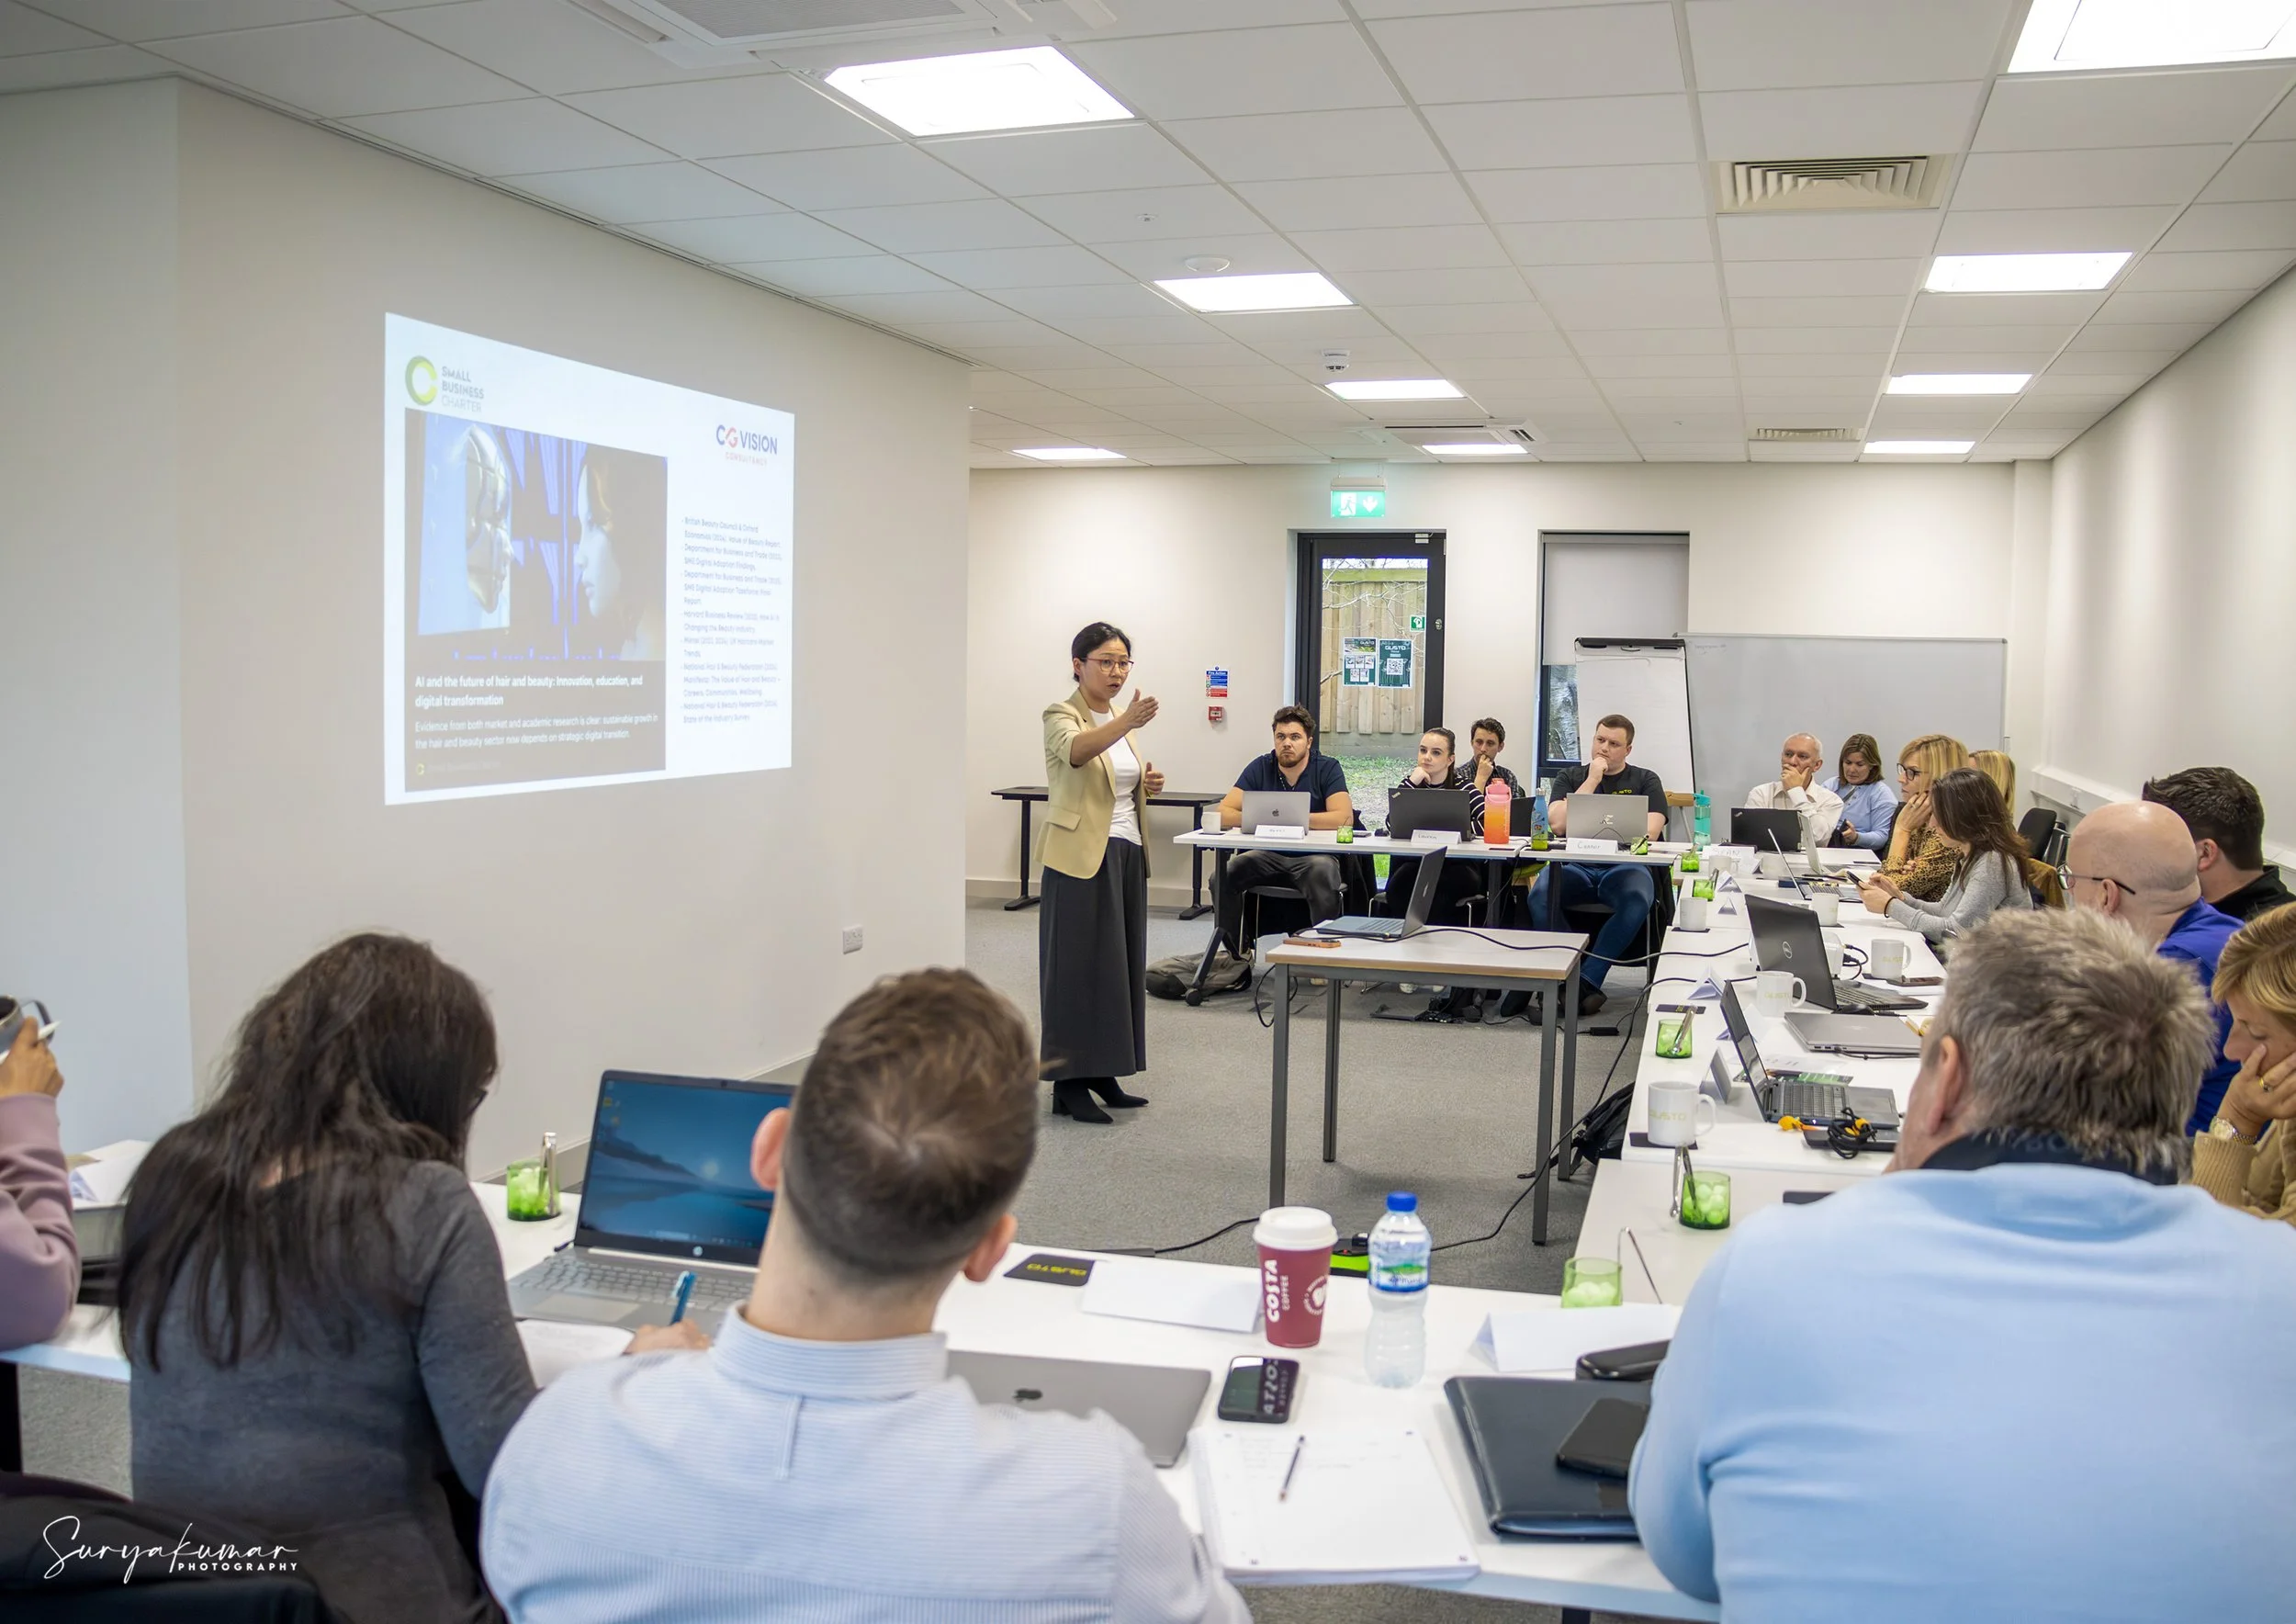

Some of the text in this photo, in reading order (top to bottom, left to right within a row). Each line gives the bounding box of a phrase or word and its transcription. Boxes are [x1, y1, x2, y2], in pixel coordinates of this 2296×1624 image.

[442, 366, 471, 383] SMALL
[442, 380, 485, 400] BUSINESS
[442, 394, 482, 412] CHARTER
[715, 424, 778, 456] CG VISION
[701, 519, 719, 530] Beauty
[719, 521, 737, 531] Council
[684, 543, 715, 554] Department
[723, 547, 744, 557] Business
[713, 559, 735, 570] Adoption
[683, 570, 715, 581] Department
[415, 675, 425, 688] AI
[426, 675, 443, 688] and
[444, 675, 458, 688] the
[459, 675, 485, 688] future
[485, 675, 494, 688] of
[495, 675, 512, 687] hair
[512, 675, 526, 687] and
[527, 675, 556, 690] beauty:
[595, 674, 630, 688] education,
[630, 673, 643, 686] and
[415, 694, 504, 710] digital transformation
[415, 720, 449, 733] Evidence
[449, 719, 467, 731] from
[467, 718, 484, 730] both
[484, 718, 508, 729] market
[509, 718, 522, 728] and
[522, 716, 552, 728] academic
[553, 716, 580, 727] research
[602, 714, 634, 725] sustainable
[634, 713, 652, 726] growth
[415, 738, 428, 750] the
[428, 738, 443, 749] hair
[444, 737, 458, 748] and
[458, 737, 483, 750] beauty
[483, 735, 505, 746] sector
[505, 736, 520, 745] now
[521, 733, 548, 745] depends
[548, 734, 557, 742] on
[557, 731, 584, 743] strategic
[584, 731, 602, 742] digital
[1026, 1263, 1087, 1277] GUSTO
[1264, 1259, 1280, 1323] COSTA
[1279, 1274, 1290, 1312] COFFEE
